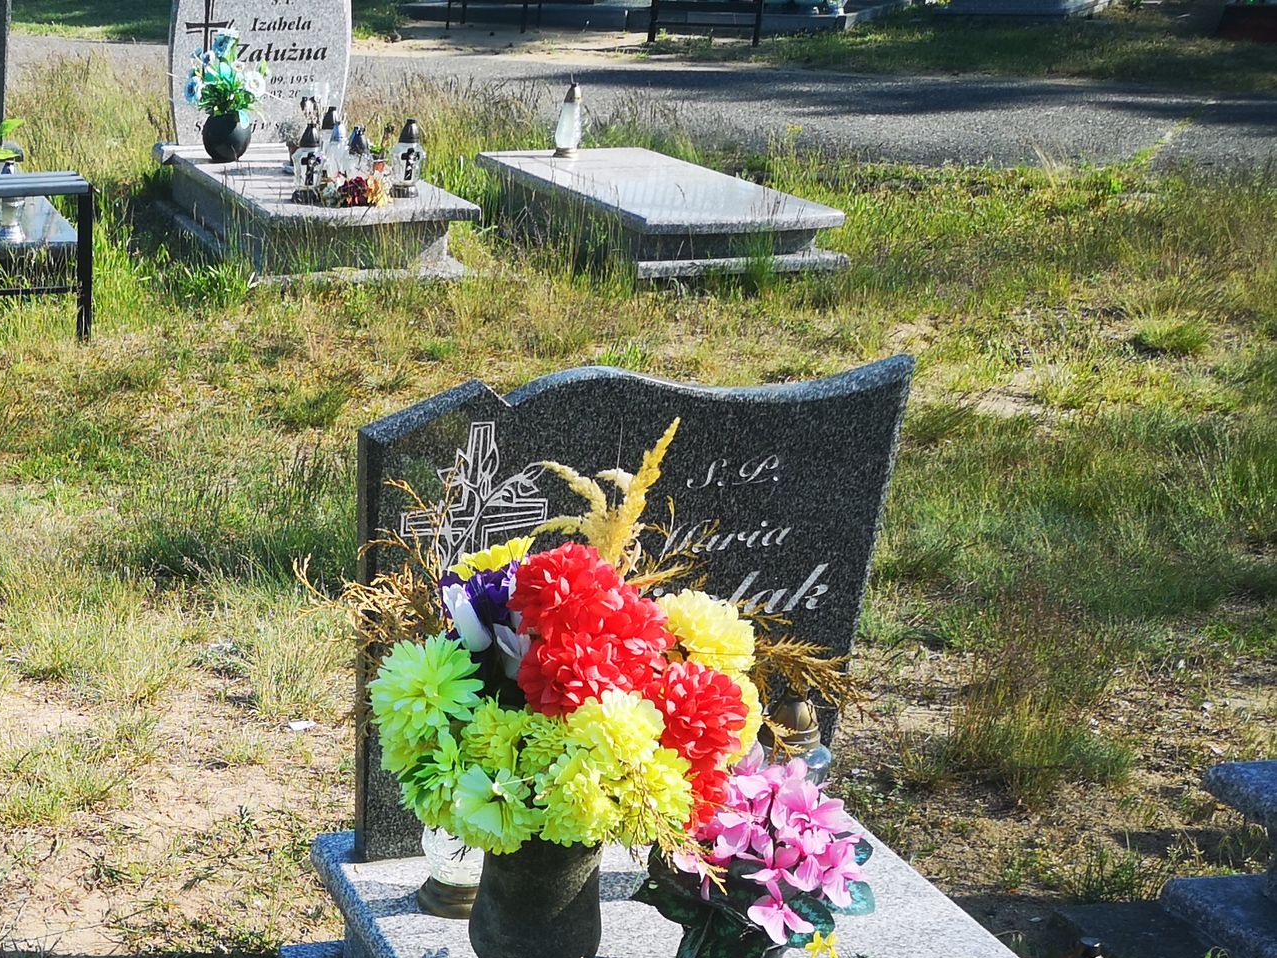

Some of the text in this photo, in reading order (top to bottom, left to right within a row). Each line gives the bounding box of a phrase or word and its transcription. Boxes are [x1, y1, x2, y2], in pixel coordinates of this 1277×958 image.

[251, 16, 312, 32] Izabela
[236, 43, 328, 63] Załużna
[290, 74, 315, 85] 1955
